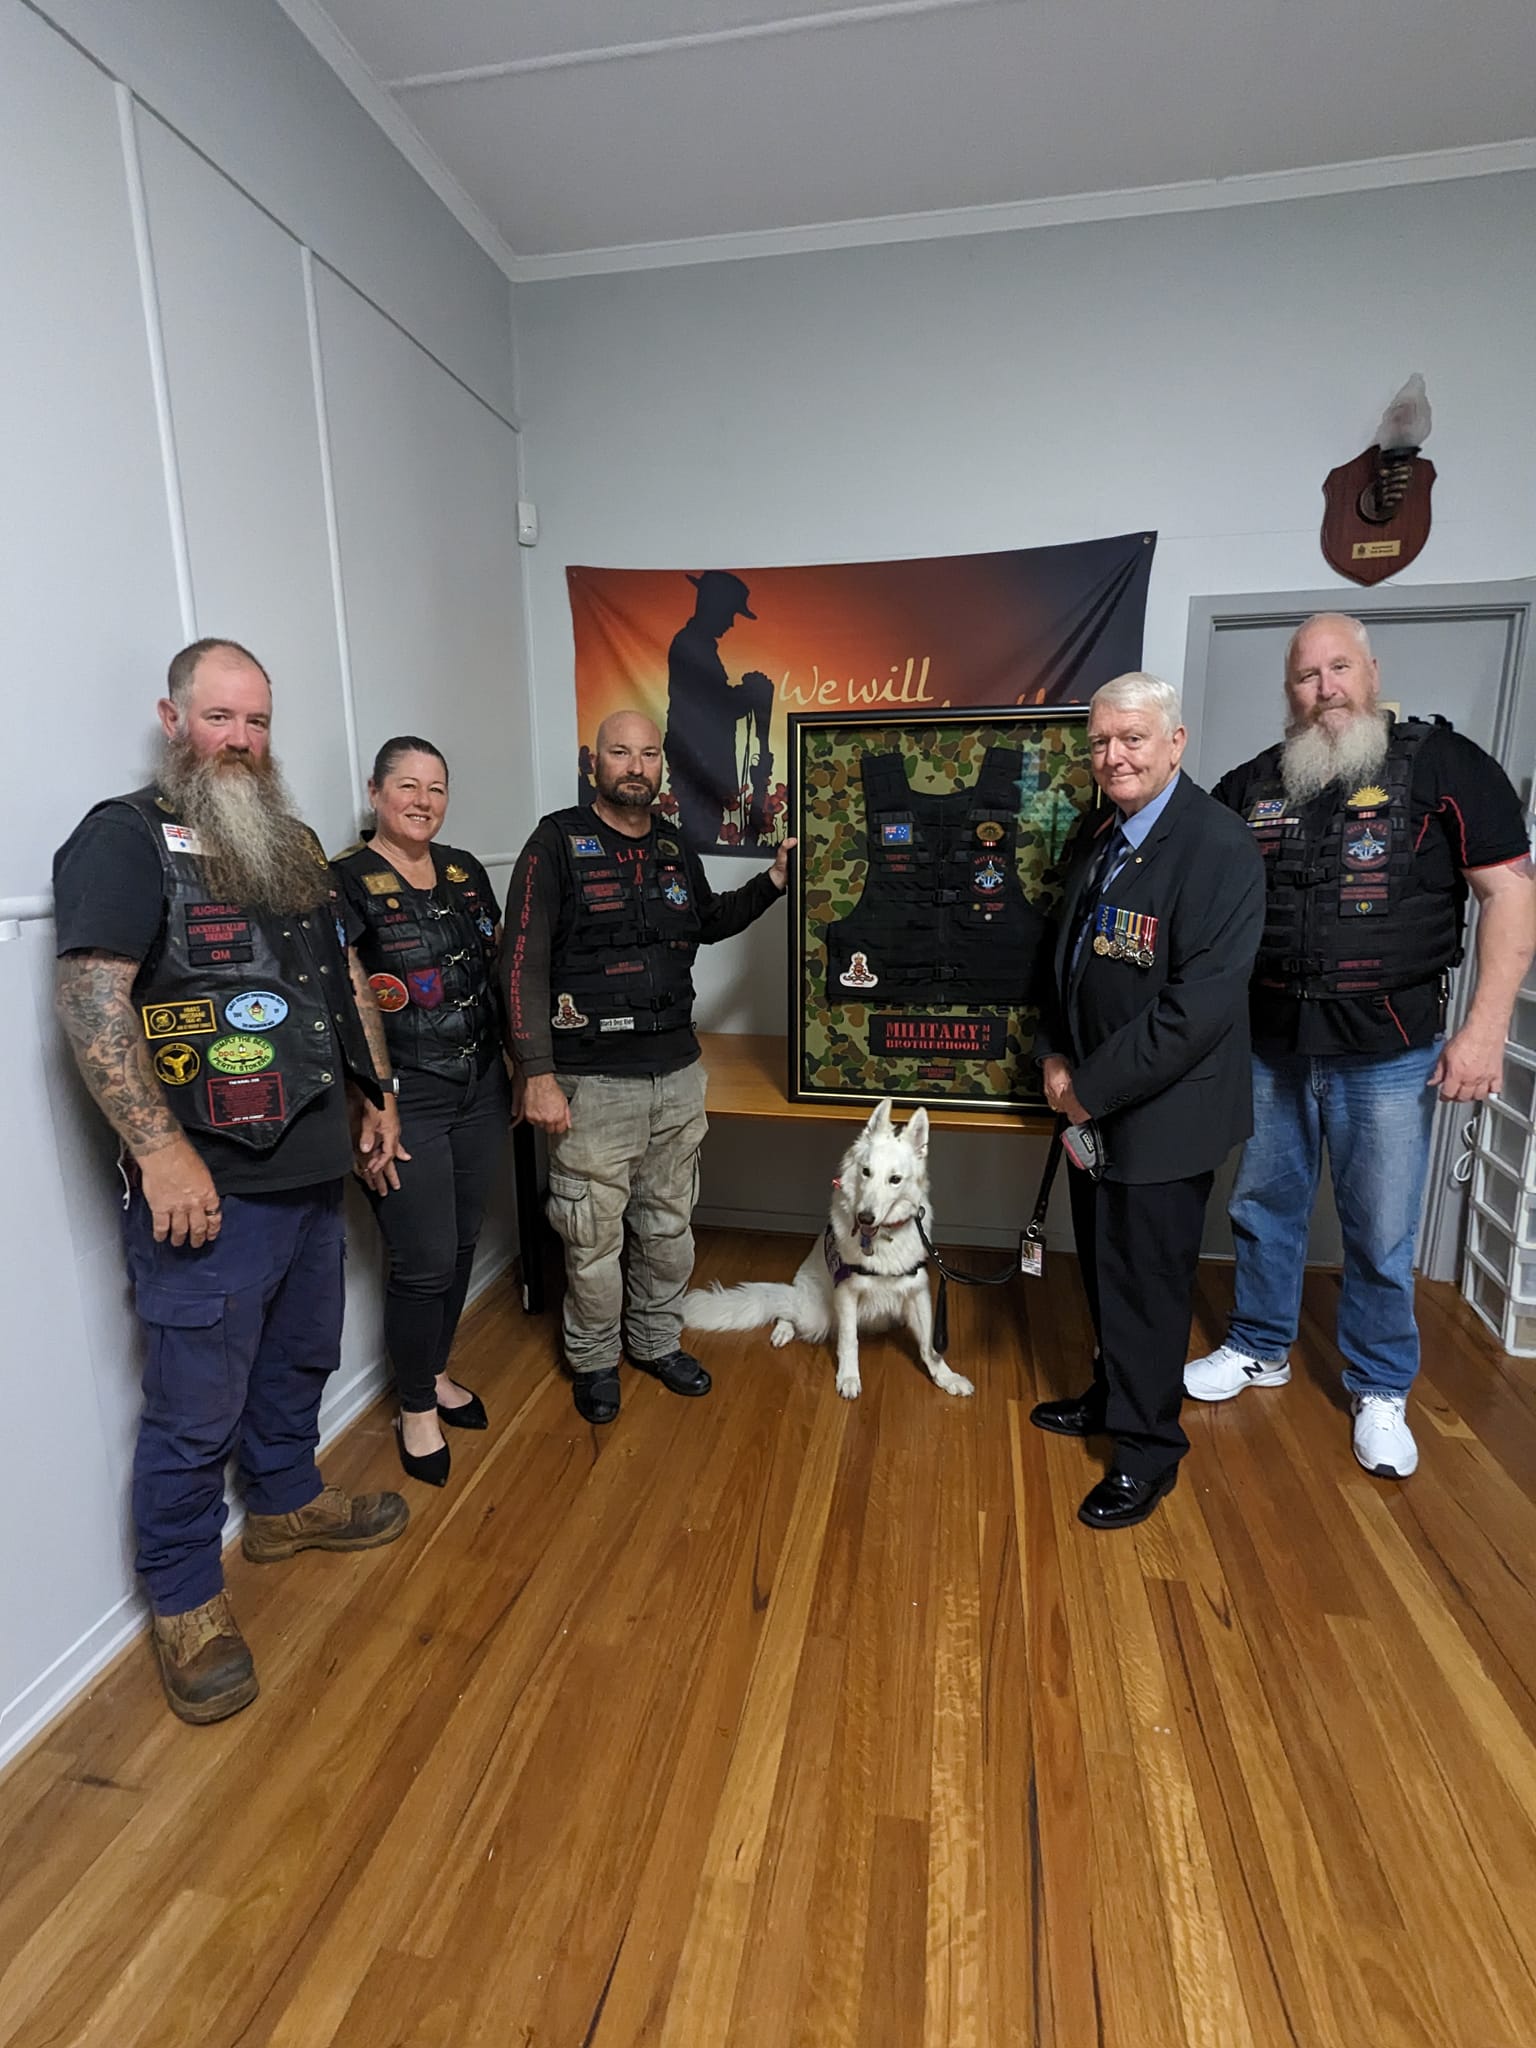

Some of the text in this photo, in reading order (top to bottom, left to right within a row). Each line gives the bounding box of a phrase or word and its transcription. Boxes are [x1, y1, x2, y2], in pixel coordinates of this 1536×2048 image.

[778, 656, 934, 706] We will
[211, 949, 231, 960] QM
[885, 1023, 979, 1040] MILITARY
[885, 1040, 980, 1050] BROTHERHOOD
[212, 1055, 271, 1072] PERTH STOKERS
